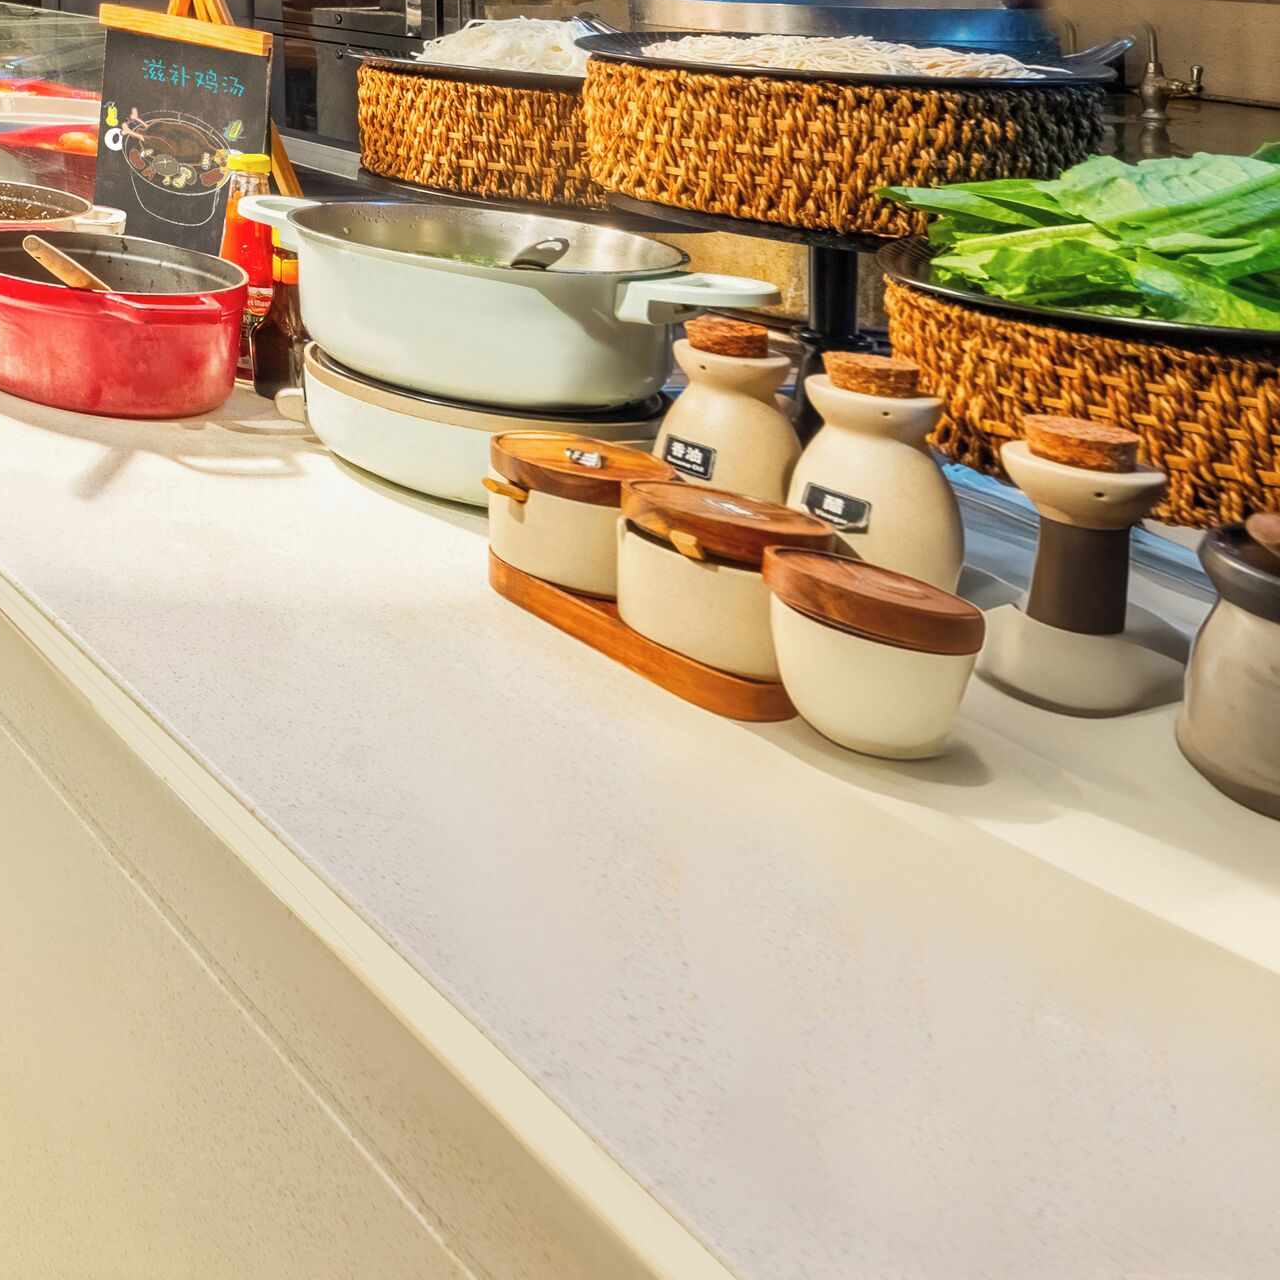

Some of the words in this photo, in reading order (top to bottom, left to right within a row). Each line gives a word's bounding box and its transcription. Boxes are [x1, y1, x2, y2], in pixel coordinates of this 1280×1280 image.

[141, 58, 246, 98] 滋补鸡汤
[671, 441, 704, 465] 香油
